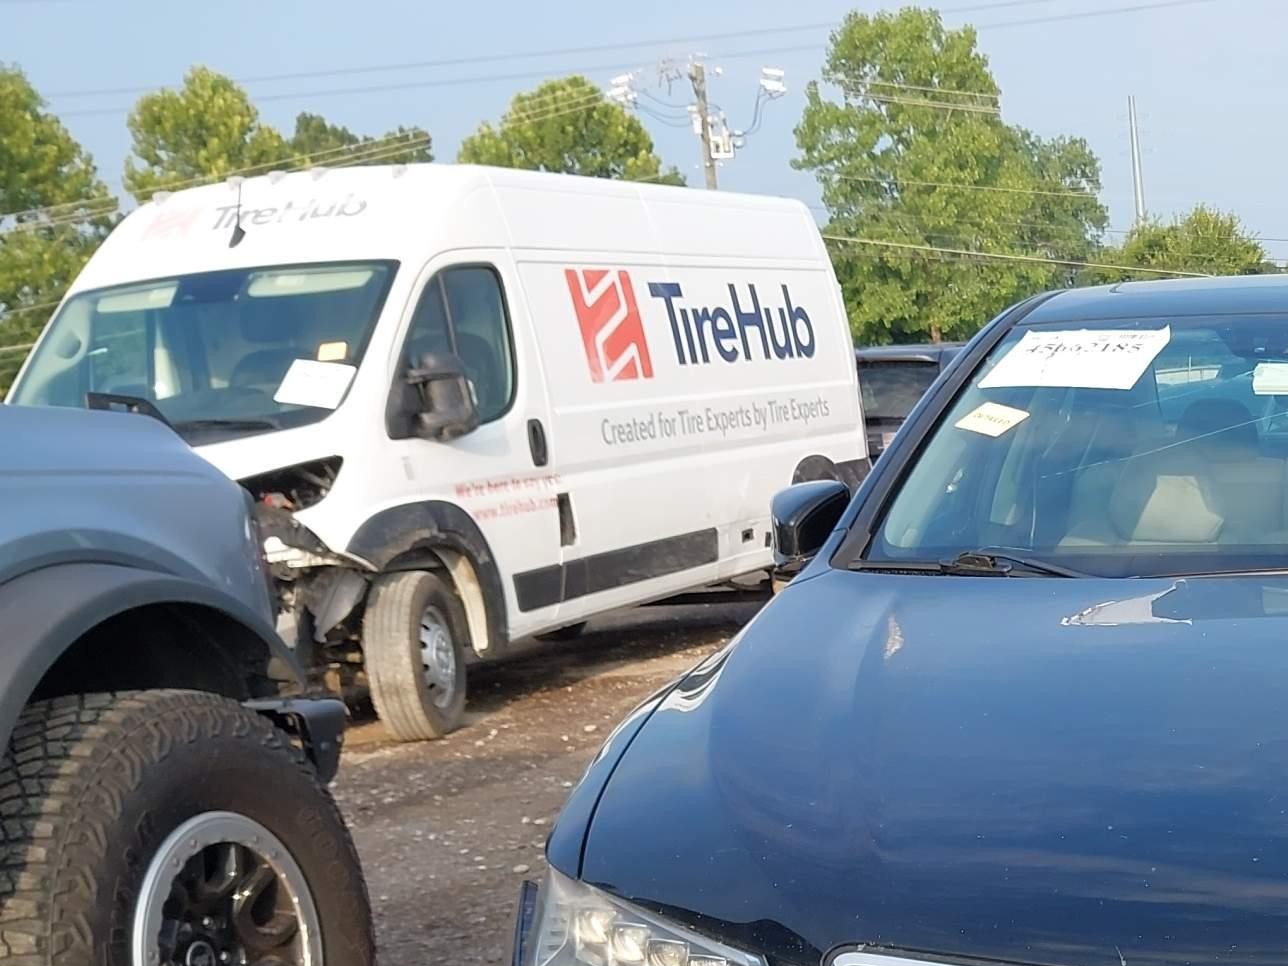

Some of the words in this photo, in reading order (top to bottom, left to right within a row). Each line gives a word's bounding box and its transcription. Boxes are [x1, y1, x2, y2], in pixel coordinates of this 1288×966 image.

[648, 282, 815, 364] TireHub
[601, 414, 656, 446] Created
[658, 411, 677, 438] for
[678, 409, 703, 436] Tire
[706, 406, 751, 437] Experts
[753, 401, 767, 431] by
[768, 399, 789, 424] Tire
[790, 396, 830, 424] Experts
